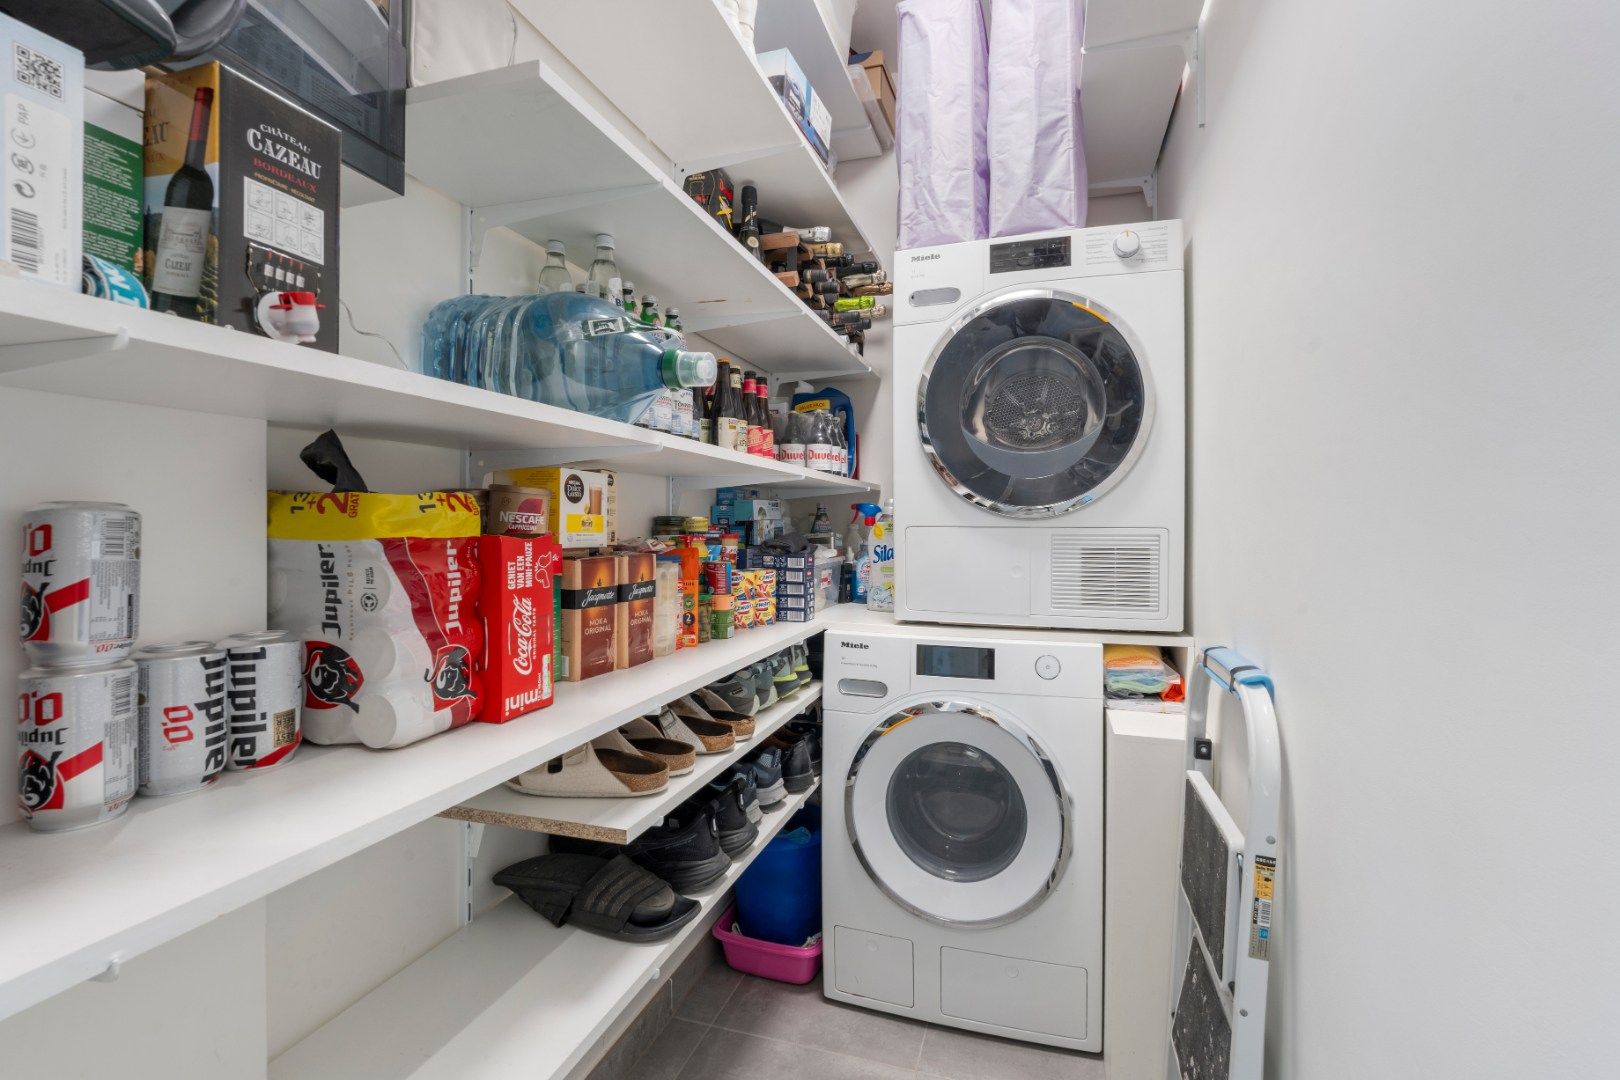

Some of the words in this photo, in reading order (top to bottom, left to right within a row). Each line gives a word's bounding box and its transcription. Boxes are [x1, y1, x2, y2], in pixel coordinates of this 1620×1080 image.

[259, 123, 312, 154] CHÂTEAU
[246, 128, 322, 180] CAZEAU
[252, 157, 318, 193] BORDEAUX
[911, 253, 941, 263] Miele
[316, 491, 349, 515] 2
[507, 561, 516, 590] GENIET
[516, 555, 525, 571] EEN
[524, 541, 534, 588] MINI-PAUZE
[318, 543, 342, 640] Jupiler
[444, 539, 464, 636] Jupiler
[516, 571, 525, 589] VAN
[512, 594, 533, 676] Coca-Cola
[584, 624, 612, 636] ORIGINAL
[589, 617, 608, 627] MOKA
[630, 615, 652, 626] ORIGINAL
[840, 641, 870, 650] Miele
[227, 646, 267, 768] Jupiler
[505, 689, 539, 717] mini
[160, 705, 194, 747] 0,0
